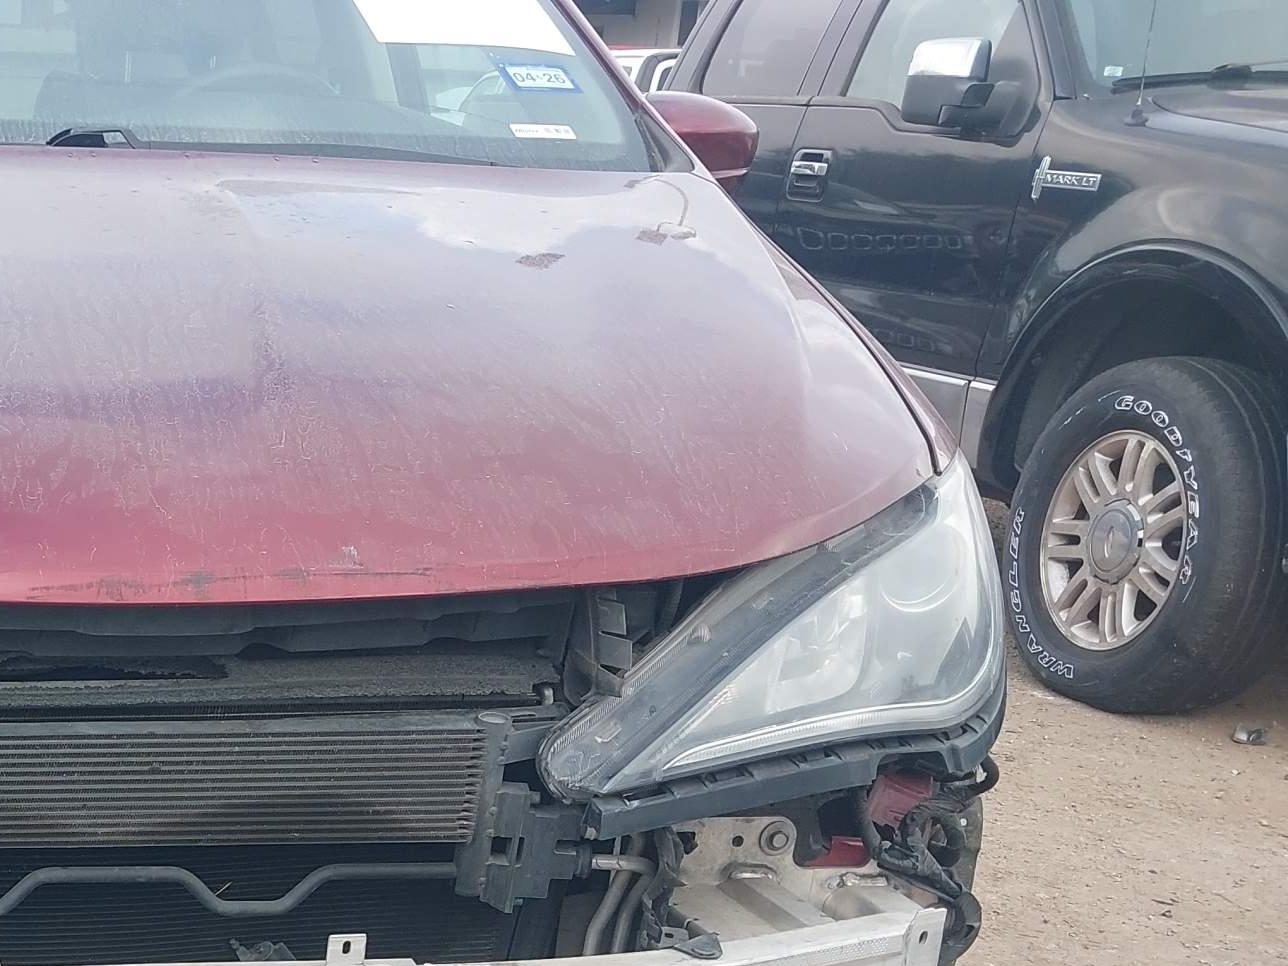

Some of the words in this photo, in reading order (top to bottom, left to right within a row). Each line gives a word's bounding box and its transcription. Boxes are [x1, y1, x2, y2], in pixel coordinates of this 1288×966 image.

[1046, 174, 1081, 185] MARK
[1082, 177, 1097, 186] LT
[1114, 395, 1200, 585] GOODYEAR
[1008, 507, 1075, 680] WRANGLER
